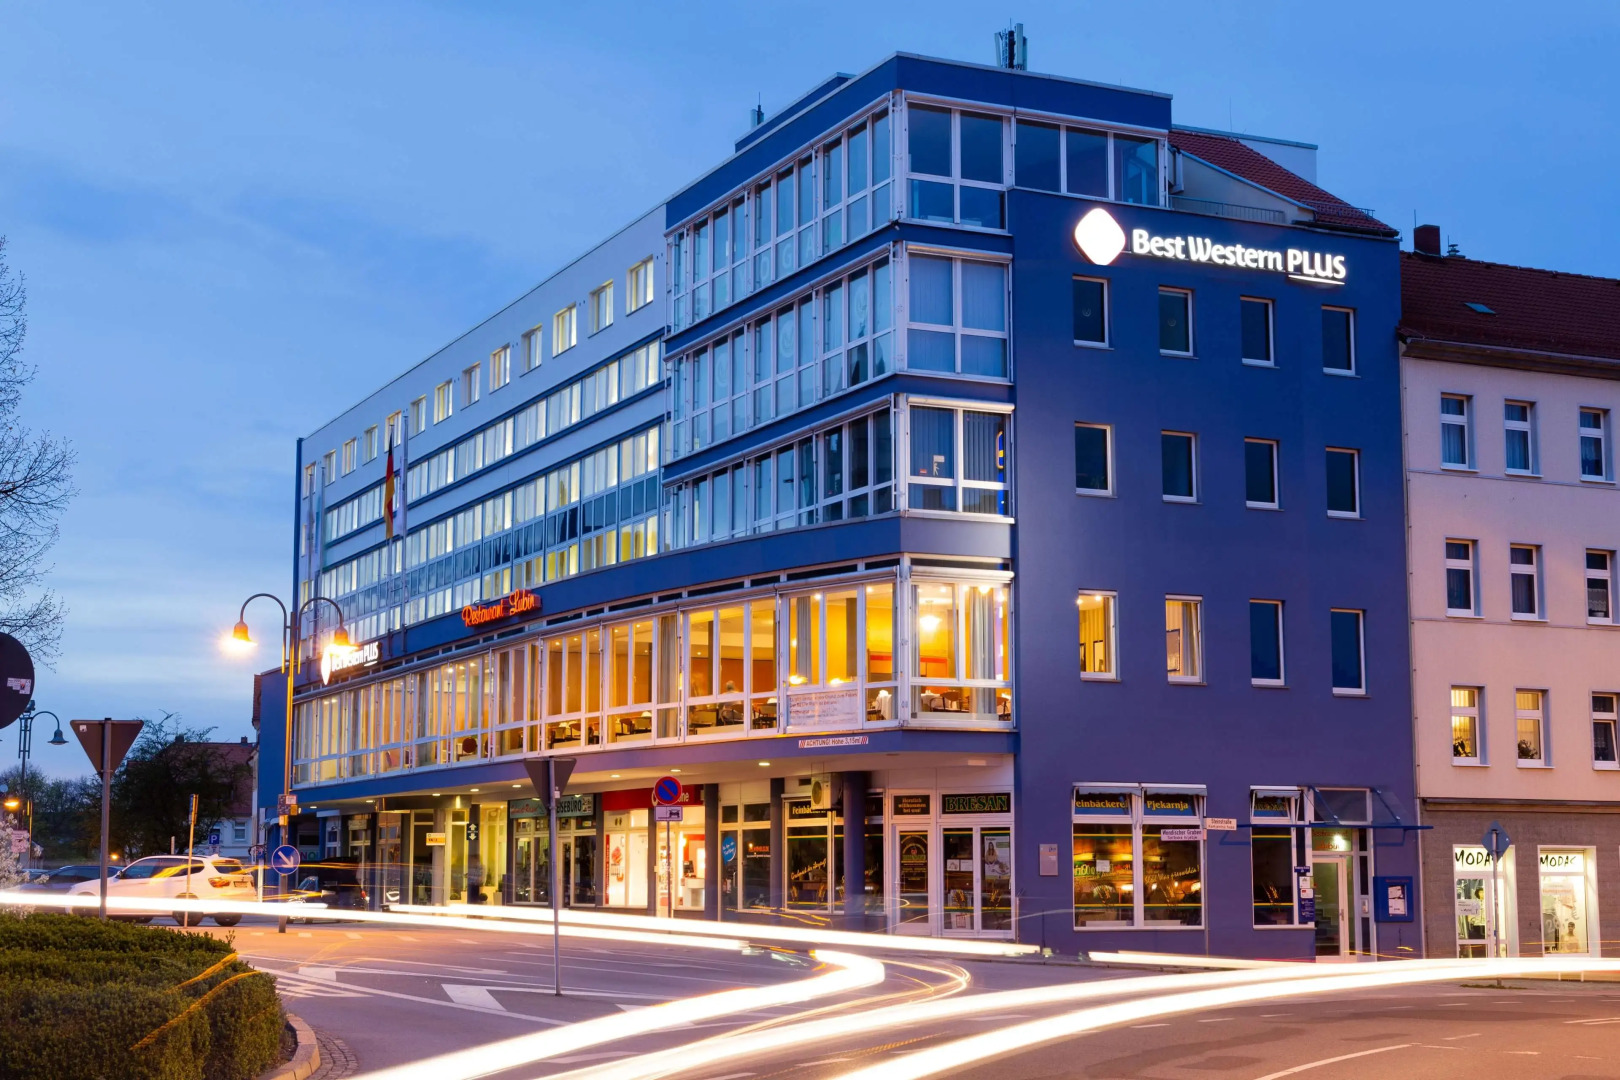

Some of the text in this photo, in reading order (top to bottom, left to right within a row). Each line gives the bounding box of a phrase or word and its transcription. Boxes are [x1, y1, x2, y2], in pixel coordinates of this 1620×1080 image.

[1132, 228, 1346, 279] Best Western PLUS
[462, 588, 535, 627] Restaurant Lubin
[806, 738, 830, 747] ACHTUNG!
[945, 796, 1008, 812] BRESAN
[1146, 800, 1189, 811] Pjekarnja
[210, 834, 218, 844] P
